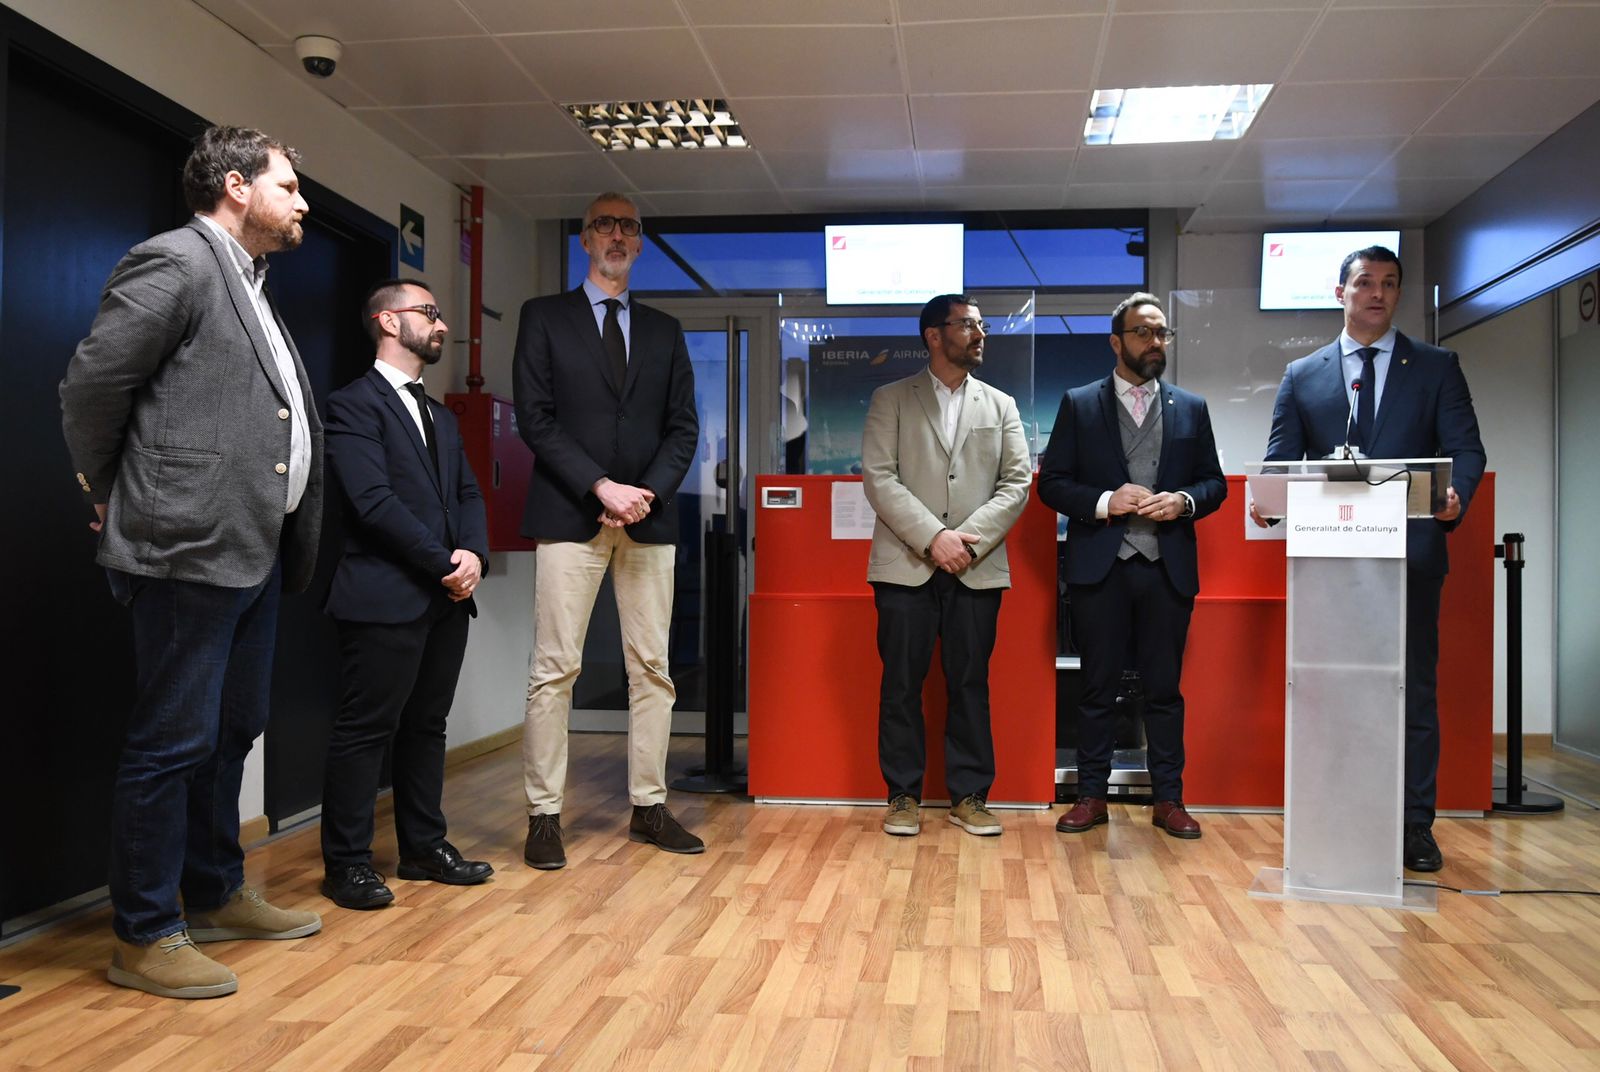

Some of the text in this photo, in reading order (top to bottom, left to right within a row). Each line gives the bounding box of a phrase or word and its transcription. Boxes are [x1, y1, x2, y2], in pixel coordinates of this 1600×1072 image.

[822, 350, 930, 360] IBERIA AIRNO
[1294, 524, 1398, 534] Generalitat de Catalunya
